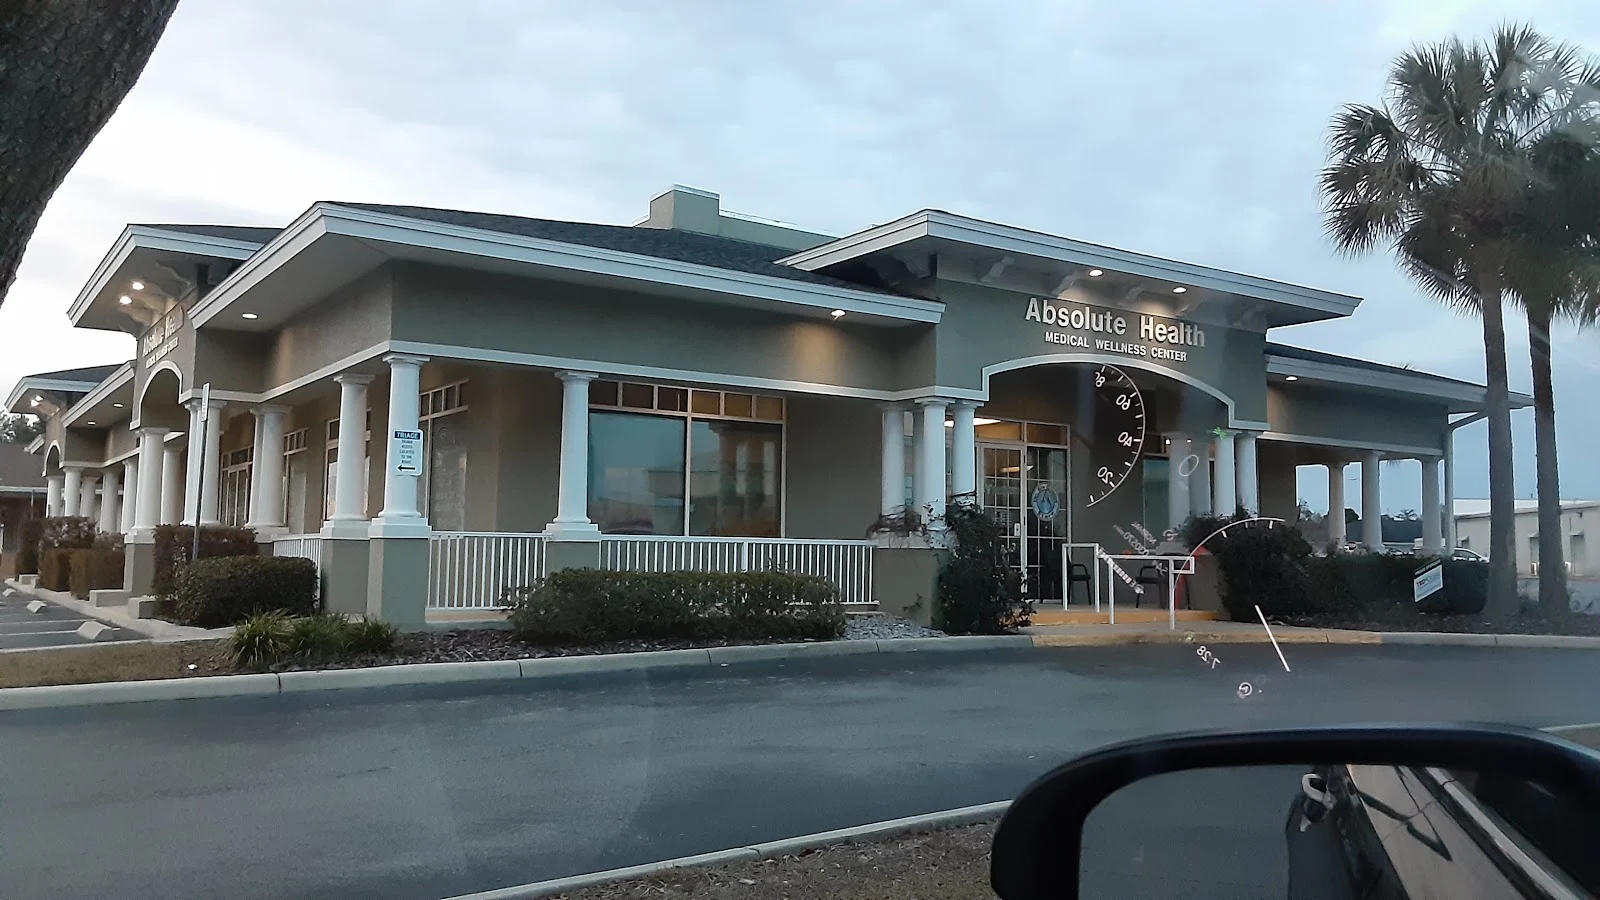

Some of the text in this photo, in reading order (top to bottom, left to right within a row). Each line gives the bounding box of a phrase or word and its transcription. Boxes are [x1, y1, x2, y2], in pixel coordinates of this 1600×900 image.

[1025, 297, 1205, 347] Absolute Health
[1045, 331, 1187, 362] MEDICAL WELLNESS CENTER
